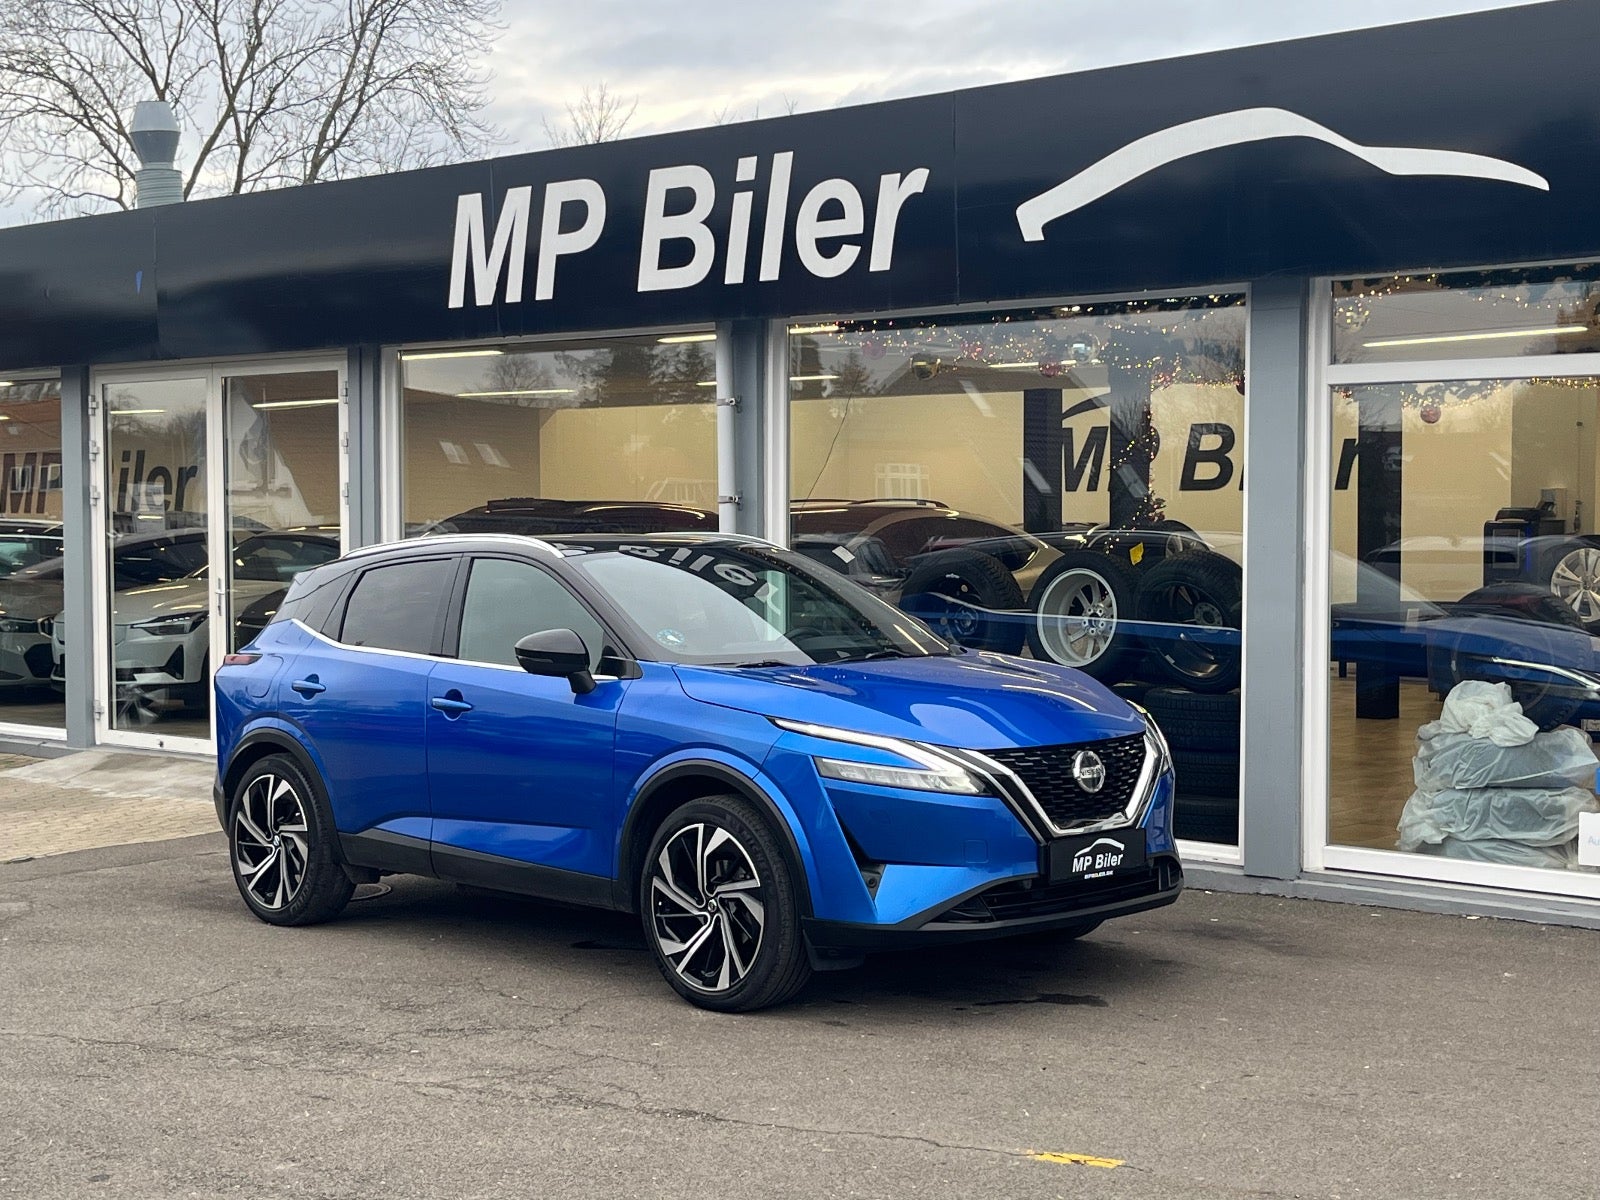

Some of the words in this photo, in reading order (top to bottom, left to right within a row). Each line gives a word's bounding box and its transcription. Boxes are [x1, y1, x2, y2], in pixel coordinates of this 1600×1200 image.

[448, 178, 606, 308] MP
[637, 151, 929, 292] Biler
[112, 450, 197, 513] iler
[1072, 856, 1093, 873] MP
[1095, 852, 1124, 869] Biler
